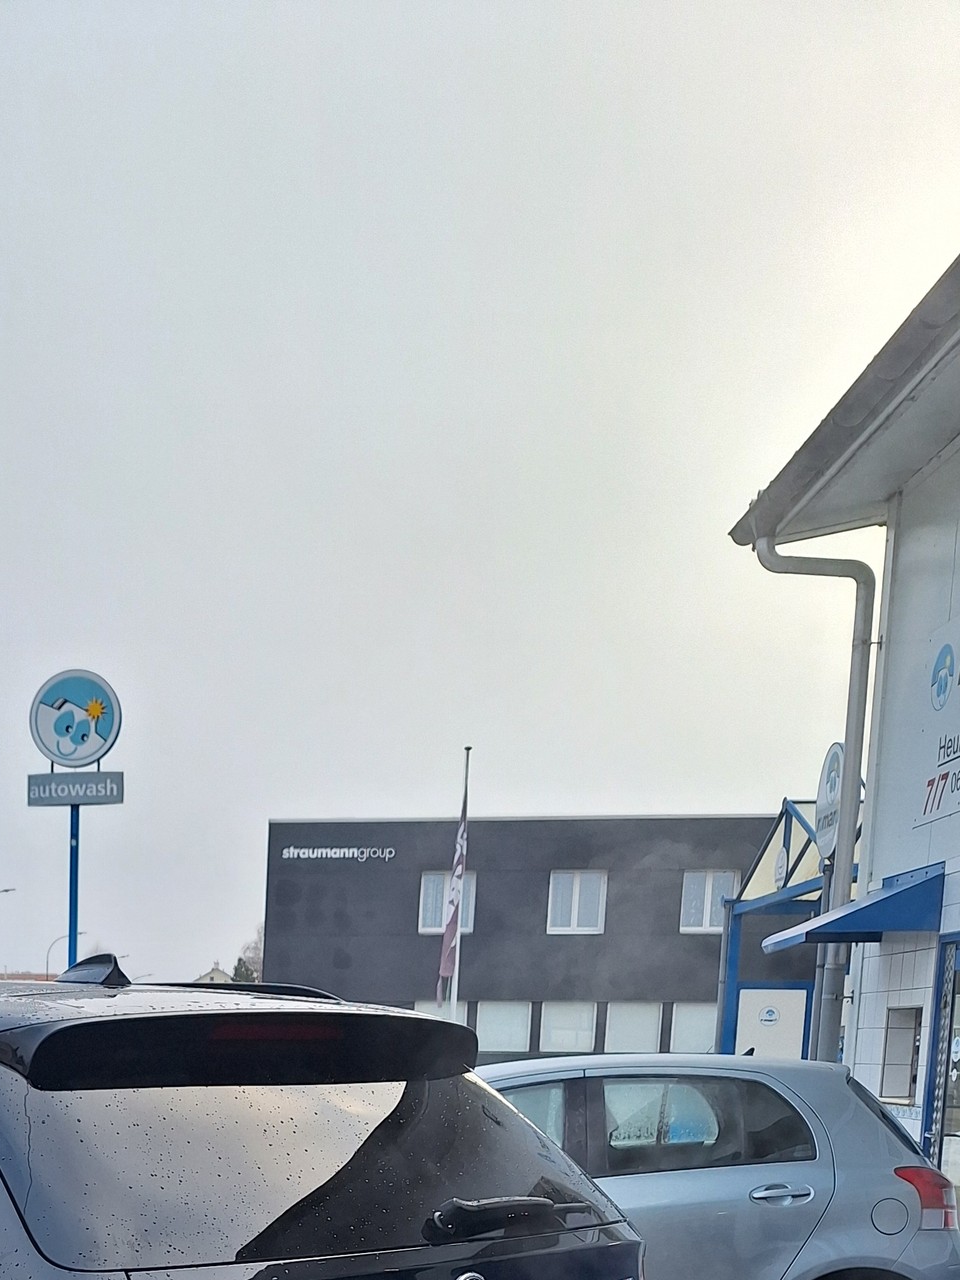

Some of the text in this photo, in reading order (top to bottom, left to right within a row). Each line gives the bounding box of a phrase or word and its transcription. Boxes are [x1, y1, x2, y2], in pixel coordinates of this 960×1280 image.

[938, 734, 960, 762] Heu
[30, 779, 117, 798] autowash
[282, 846, 396, 862] straumanngroup
